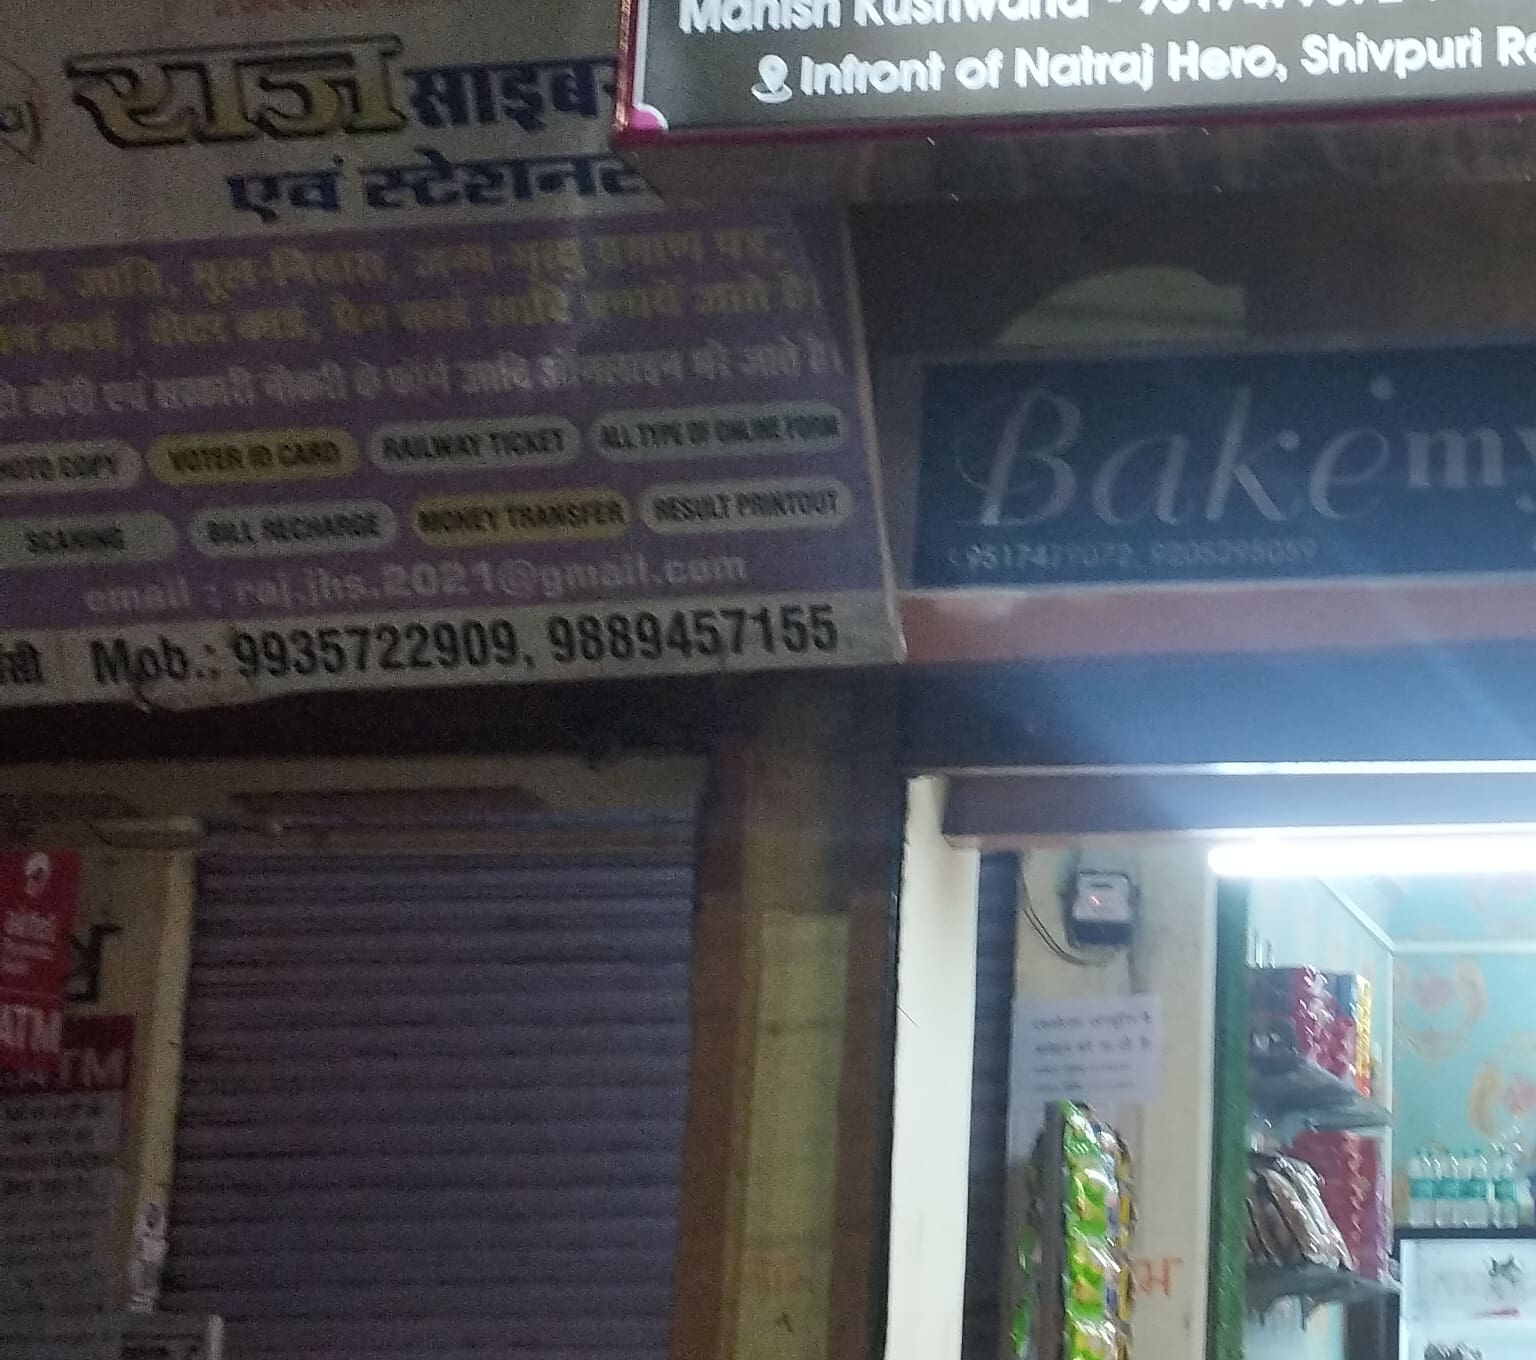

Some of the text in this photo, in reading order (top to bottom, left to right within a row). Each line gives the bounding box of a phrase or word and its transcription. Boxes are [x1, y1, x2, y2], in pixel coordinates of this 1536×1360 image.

[403, 56, 617, 131] साइब
[799, 52, 946, 97] Infront
[956, 48, 1003, 91] of
[1013, 41, 1155, 93] Natraj
[1166, 39, 1289, 85] Hero,
[1299, 25, 1483, 79] Shivpuri
[226, 153, 346, 224] एवं
[953, 385, 1390, 527] Bake
[417, 498, 626, 535] MONEY TRANSFER
[653, 493, 730, 522] RESULT
[548, 604, 838, 665] 9889457155
